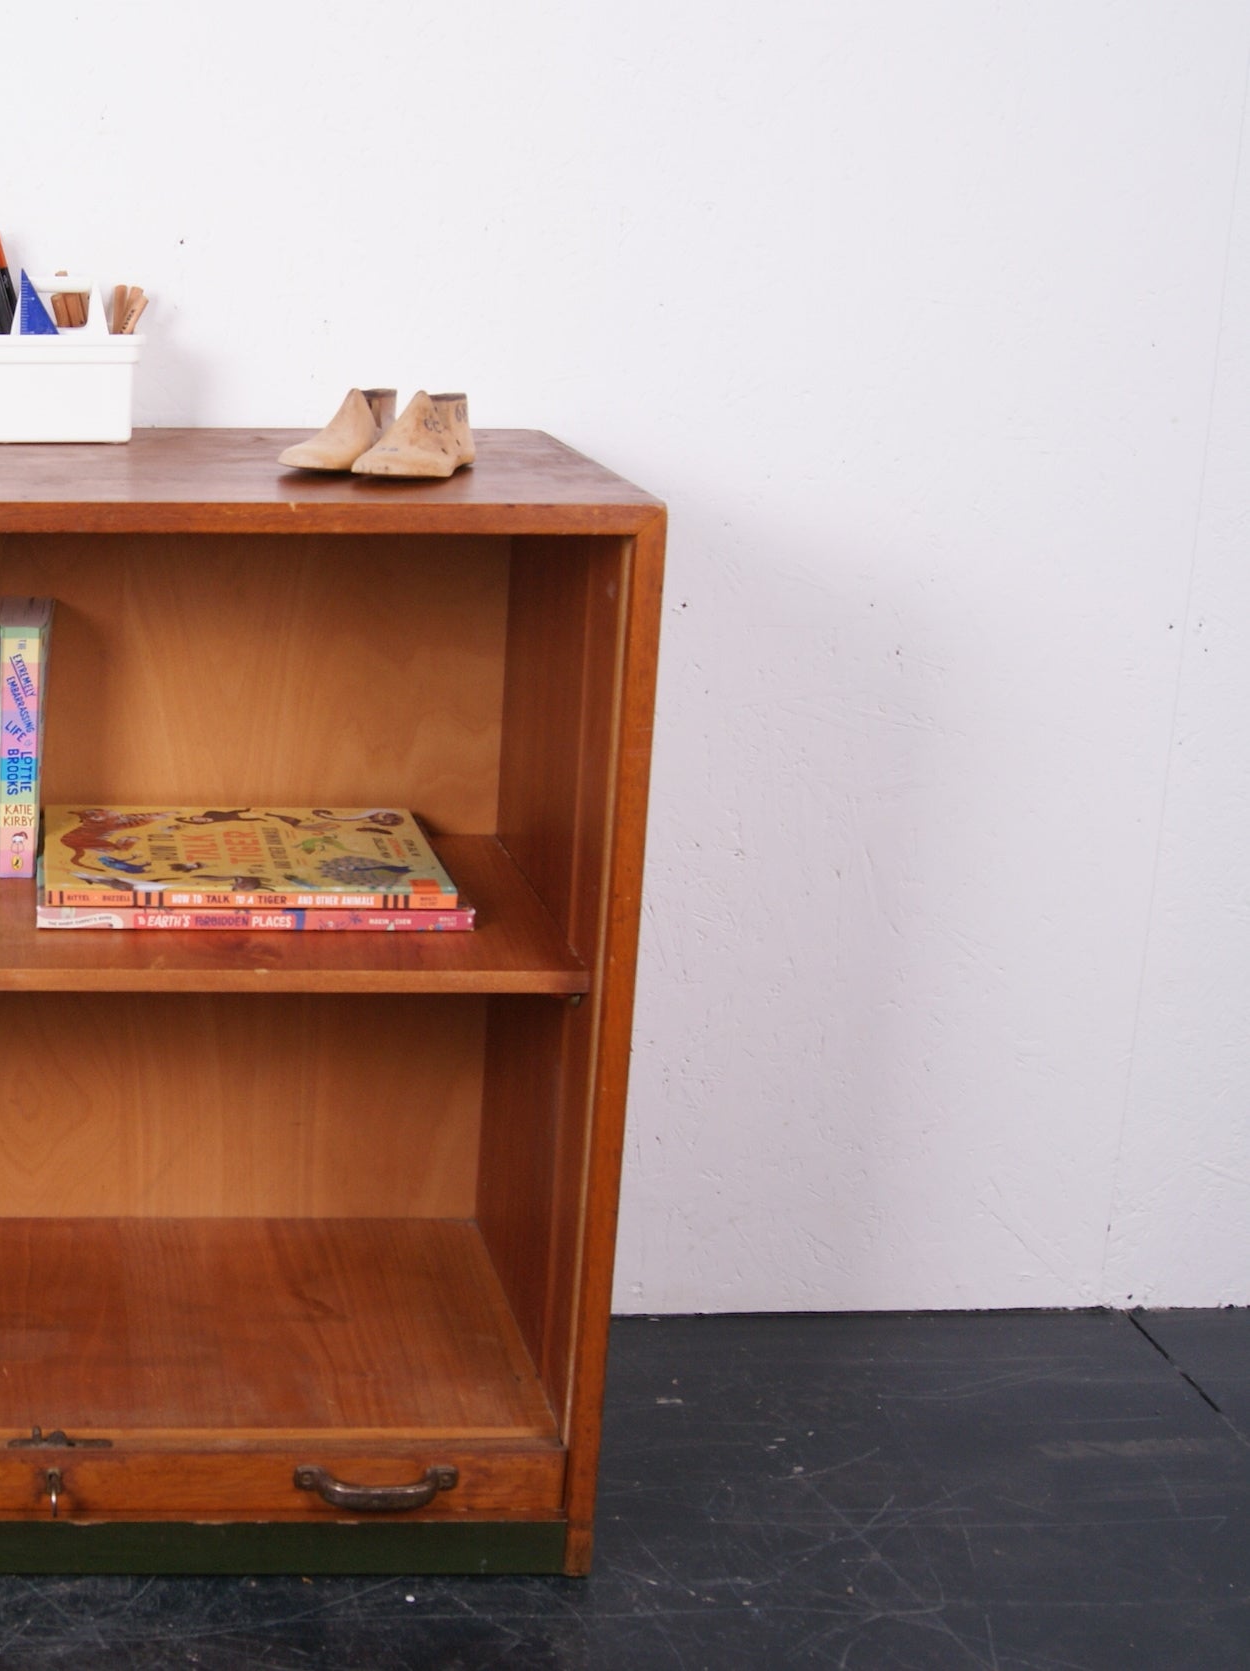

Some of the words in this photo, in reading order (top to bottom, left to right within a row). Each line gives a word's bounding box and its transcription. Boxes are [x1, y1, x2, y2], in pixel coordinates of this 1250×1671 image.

[12, 653, 36, 697] EXTREMELY
[6, 676, 35, 734] EMBARRASSING
[5, 720, 27, 743] LIFE
[7, 748, 19, 796] BROOKS
[20, 751, 32, 793] LOTTIE
[3, 816, 35, 827] KIRBY
[5, 804, 33, 815] KATIE
[181, 833, 222, 862] TALK
[171, 895, 191, 904] HOW
[193, 895, 202, 904] TO
[206, 895, 230, 904] TALK
[297, 895, 314, 905] AND
[316, 896, 339, 905] OTHER
[341, 896, 375, 906] ANIMALS
[147, 915, 191, 928] EARTH'S
[194, 914, 249, 926] FORBIDDEN
[252, 916, 292, 928] PLACES
